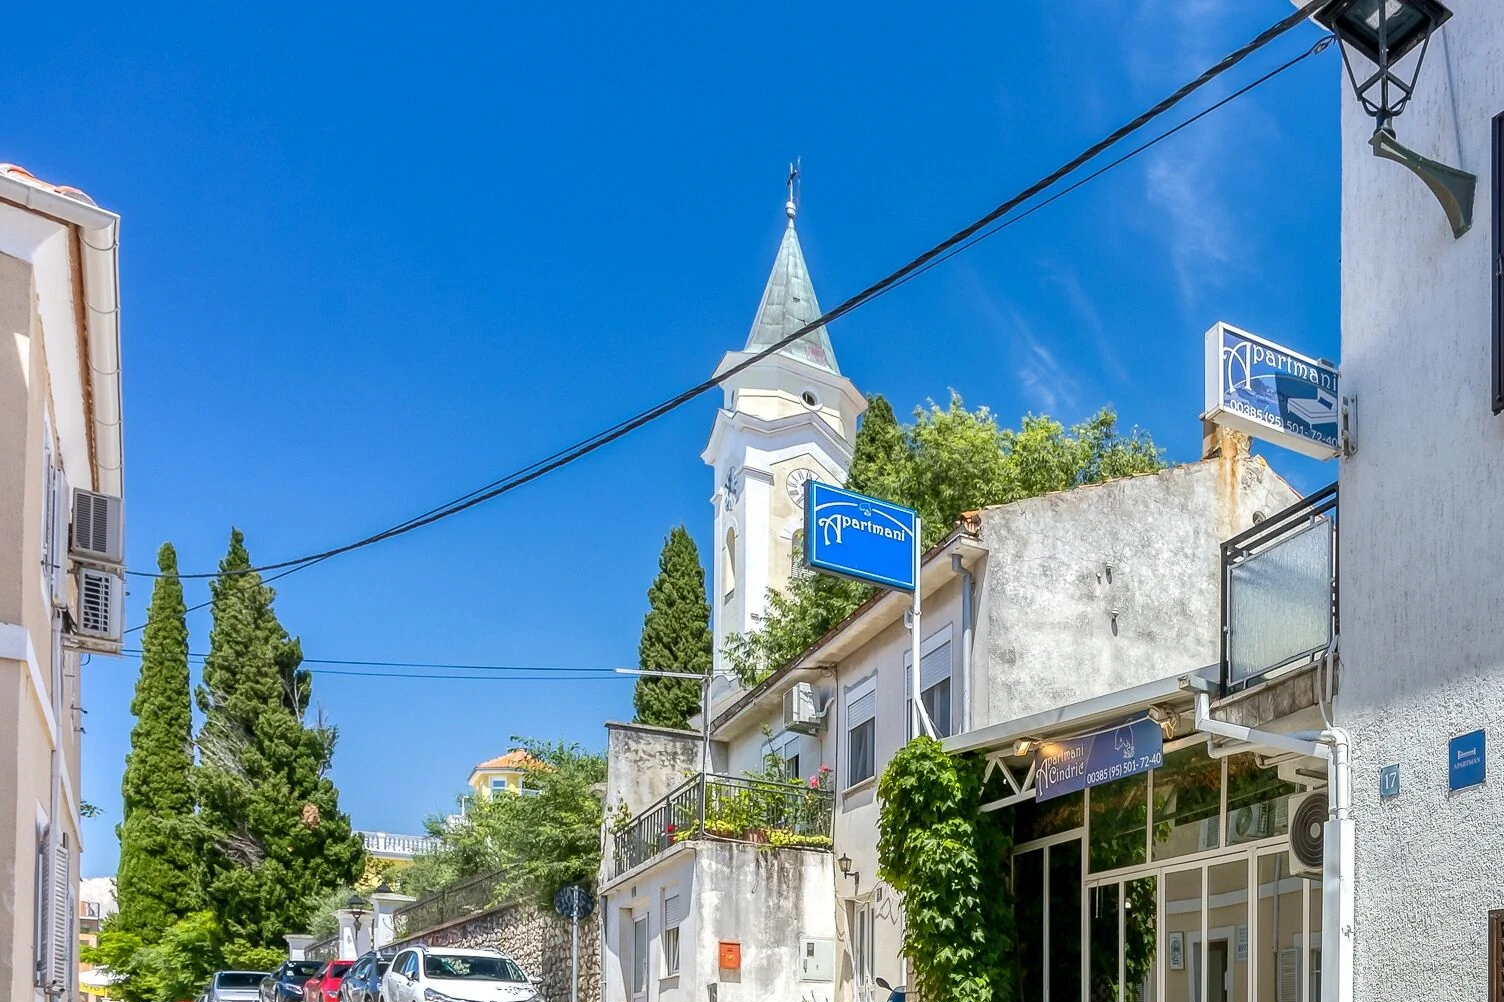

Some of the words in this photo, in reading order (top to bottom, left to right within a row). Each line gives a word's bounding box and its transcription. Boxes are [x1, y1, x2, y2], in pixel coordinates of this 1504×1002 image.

[1223, 341, 1337, 394] Apartmani
[1230, 399, 1263, 420] 00385
[1264, 412, 1285, 429] (95)
[818, 514, 905, 547] Apartmani
[1036, 743, 1084, 797] Apartmani
[1086, 768, 1108, 784] 00385
[1109, 763, 1122, 780] (95)
[1385, 772, 1397, 790] 17
